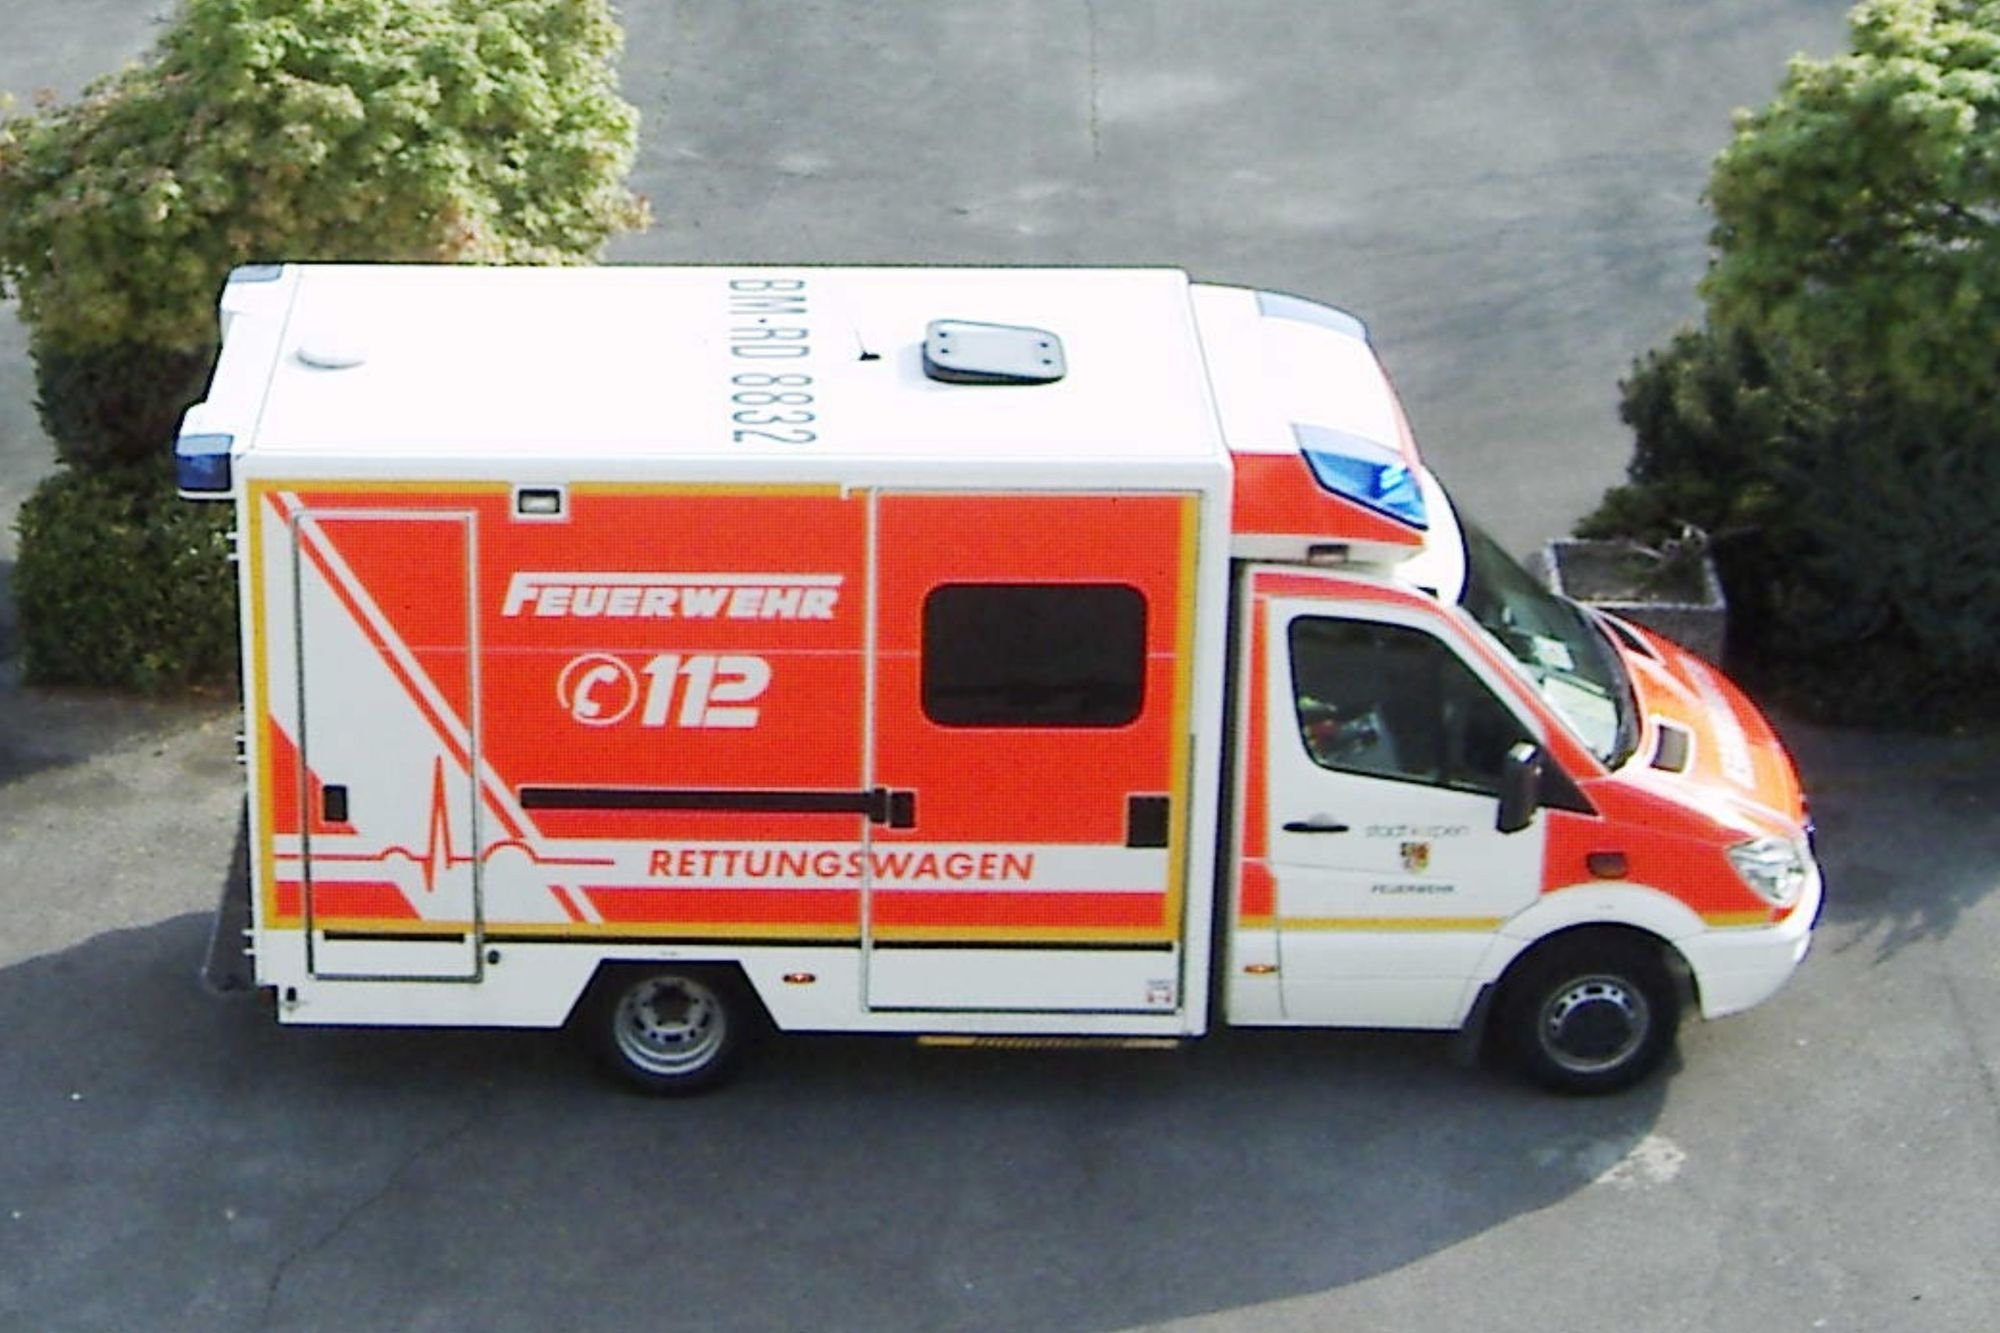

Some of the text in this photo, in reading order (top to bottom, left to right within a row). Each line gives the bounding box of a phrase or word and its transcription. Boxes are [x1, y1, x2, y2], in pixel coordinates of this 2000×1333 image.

[731, 372, 816, 443] 8832
[502, 571, 844, 619] FEUERWEHR
[641, 654, 771, 728] 112
[648, 849, 1034, 881] RETTUNGSWAGEN
